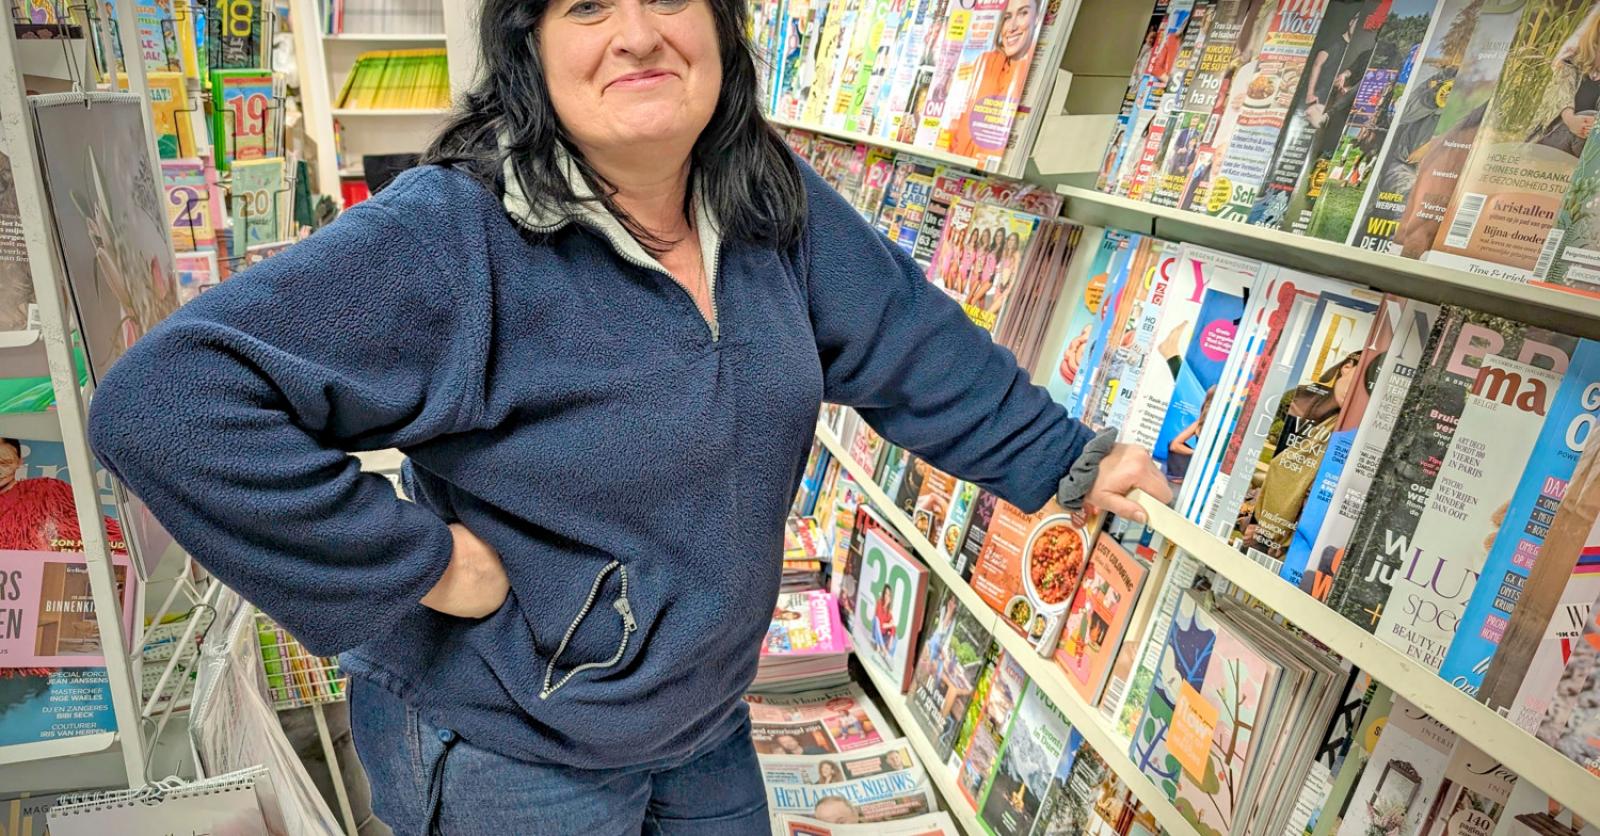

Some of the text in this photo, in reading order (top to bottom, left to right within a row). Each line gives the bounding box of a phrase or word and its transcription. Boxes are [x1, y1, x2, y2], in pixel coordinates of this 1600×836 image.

[217, 0, 253, 37] 18
[230, 94, 269, 138] 19
[926, 101, 945, 116] ON
[1487, 153, 1521, 165] HOE DE
[1483, 163, 1519, 176] CHINESE
[1489, 175, 1548, 191] GEZONDHEID
[172, 187, 203, 228] 2
[239, 189, 270, 218] 20
[1494, 199, 1554, 220] Kristallen
[1279, 459, 1303, 474] POSH
[1281, 450, 1318, 469] FOREVER
[1452, 451, 1481, 468] VIEREN
[1448, 459, 1484, 479] IN PARIJS
[1435, 493, 1466, 511] MINDER
[1438, 484, 1478, 505] WE VRIJEN
[1431, 502, 1469, 522] DAN OOIT
[860, 546, 912, 641] 30
[1406, 644, 1421, 660] EN
[46, 678, 69, 686] JEAN
[49, 694, 104, 703] INGE WAELES
[51, 688, 103, 696] MASTERCHEF
[42, 704, 109, 714] DJ EN ZANGERES
[73, 711, 95, 719] SECK
[40, 730, 55, 738] IRIS
[57, 729, 75, 737] VAN
[51, 722, 97, 730] COUTURIER
[859, 771, 916, 800] NIEUWS
[1466, 811, 1490, 830] 140
